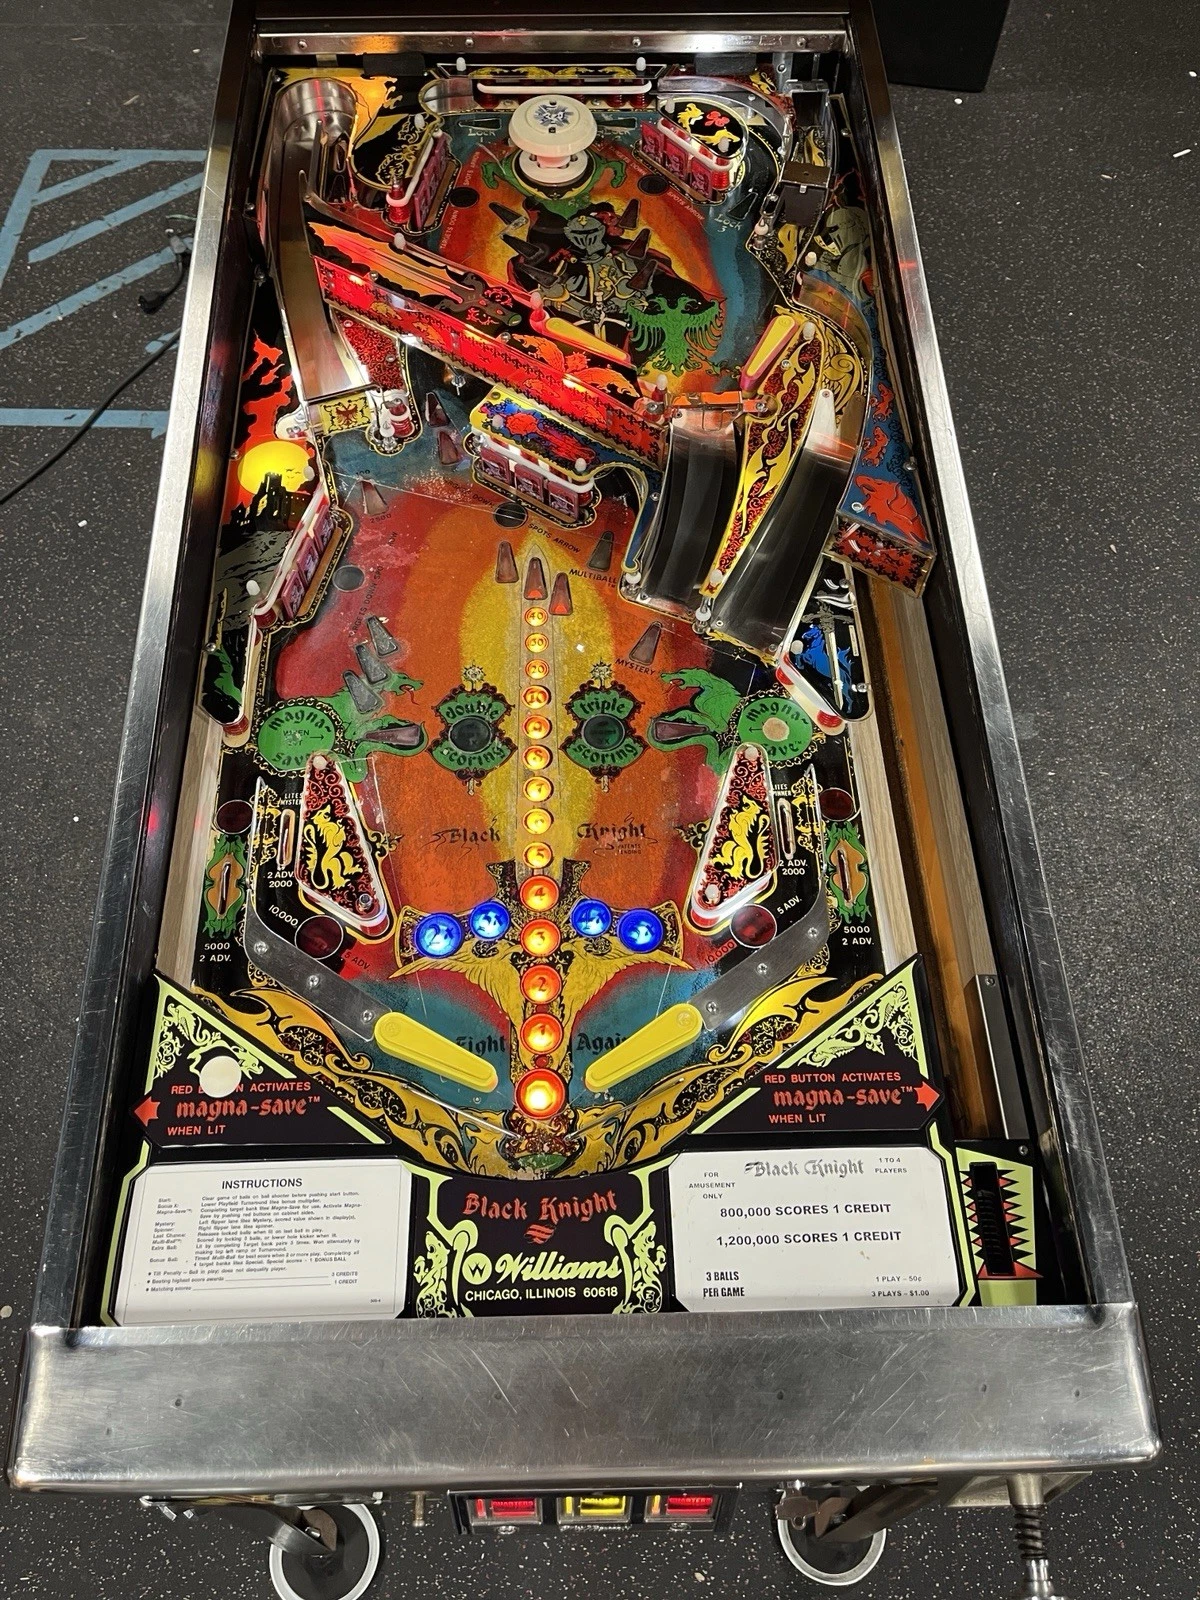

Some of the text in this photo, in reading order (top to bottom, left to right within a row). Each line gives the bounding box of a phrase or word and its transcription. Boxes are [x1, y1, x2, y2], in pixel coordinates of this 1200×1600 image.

[527, 522, 580, 554] SPOTS ARROW
[568, 568, 618, 584] MULTIBALL
[529, 610, 544, 620] 40
[530, 638, 544, 647] 30
[532, 664, 543, 672] 20
[614, 658, 656, 676] MYSTERY
[530, 691, 546, 704] 10
[445, 700, 500, 720] double
[580, 698, 626, 715] triple
[572, 743, 638, 765] scoring
[787, 859, 808, 867] ADV.
[274, 871, 294, 879] ADV.
[782, 868, 806, 876] 2000
[268, 880, 293, 888] 2000
[533, 886, 547, 900] 4
[776, 895, 802, 915] 5 ADV.
[844, 926, 870, 934] 5000
[536, 930, 547, 944] 3
[852, 937, 874, 946] ADV.
[204, 942, 230, 951] 5000
[210, 954, 232, 962] ADV.
[536, 976, 548, 993] 2
[576, 1032, 627, 1055] Agai
[764, 1072, 902, 1084] RED BUTTON ACTIVATES
[170, 1085, 193, 1095] RED
[250, 1082, 312, 1092] ACTIVATES
[768, 1114, 826, 1124] WHEN LIT
[167, 1125, 226, 1136] WHEN LIT
[746, 1158, 864, 1178] Black Knight
[222, 1178, 302, 1190] INSTRUCTIONS
[462, 1189, 618, 1225] Black Knight
[720, 1206, 771, 1219] 800,000
[776, 1204, 828, 1216] SCORES
[844, 1204, 891, 1214] CREDIT
[716, 1234, 780, 1248] 1,200,000
[784, 1232, 838, 1244] SCORES
[854, 1232, 902, 1242] CREDIT
[494, 1251, 622, 1284] Williams
[706, 1271, 740, 1282] 3 BALLS
[464, 1286, 618, 1302] CHICAGO, ILLINOIS 60618
[702, 1286, 745, 1298] PER GAME
